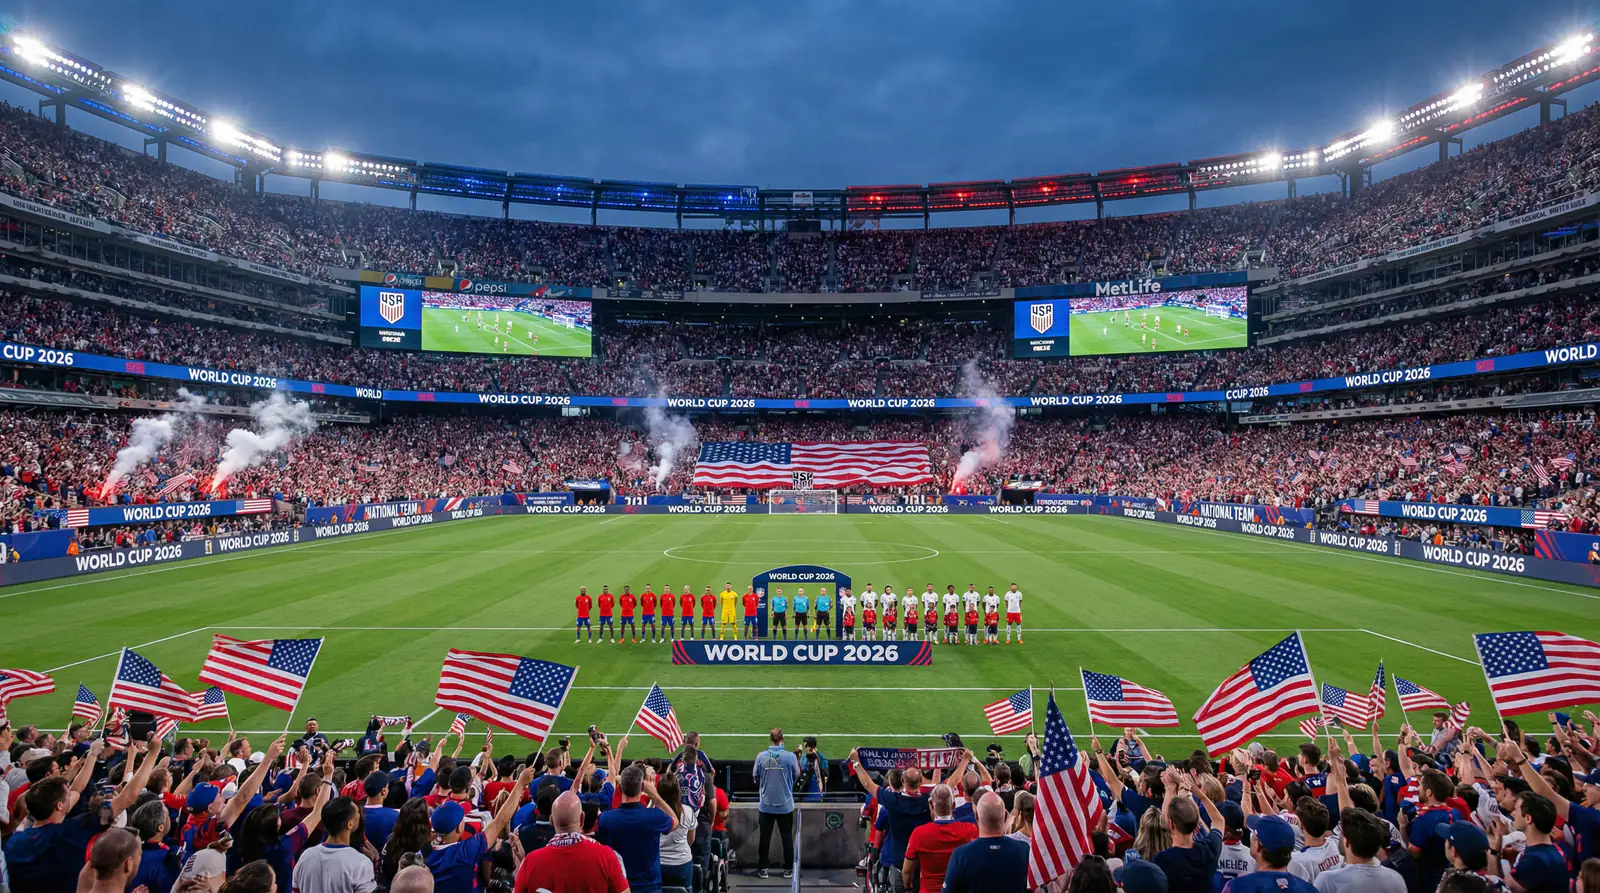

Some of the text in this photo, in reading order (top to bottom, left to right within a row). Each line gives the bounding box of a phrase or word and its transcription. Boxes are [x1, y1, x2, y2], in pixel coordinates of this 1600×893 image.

[475, 283, 506, 294] pepsi
[1096, 279, 1160, 296] MetLife
[382, 294, 402, 306] USA
[1032, 305, 1051, 316] USA
[4, 346, 74, 366] CUP 2026
[1545, 344, 1597, 363] WORLD
[188, 368, 277, 389] WORLD CUP 2026
[1346, 368, 1430, 387] WORLD CUP 2026
[356, 388, 382, 398] WORLD
[479, 394, 570, 405] WORLD CUP 2026
[1031, 395, 1122, 405] WORLD CUP 2026
[1250, 387, 1268, 398] 2026
[668, 398, 755, 408] WORLD CUP 2026
[848, 398, 935, 408] WORLD CUP 2026
[124, 504, 210, 520] WORLD CUP 2026
[400, 503, 417, 516] TEAM
[1201, 504, 1254, 522] NATIONAL TEAM
[1402, 504, 1487, 522] WORLD CUP 2026
[316, 525, 339, 537] WORLD
[341, 524, 353, 533] CUP
[1242, 522, 1294, 538] WORLD CUP 2026
[220, 532, 289, 550] WORLD CUP 2026
[1320, 532, 1388, 552] WORLD CUP 2026
[76, 545, 182, 571] WORLD CUP 2026
[1423, 546, 1525, 572] WORLD CUP 2026
[704, 644, 898, 661] WORLD CUP 2026
